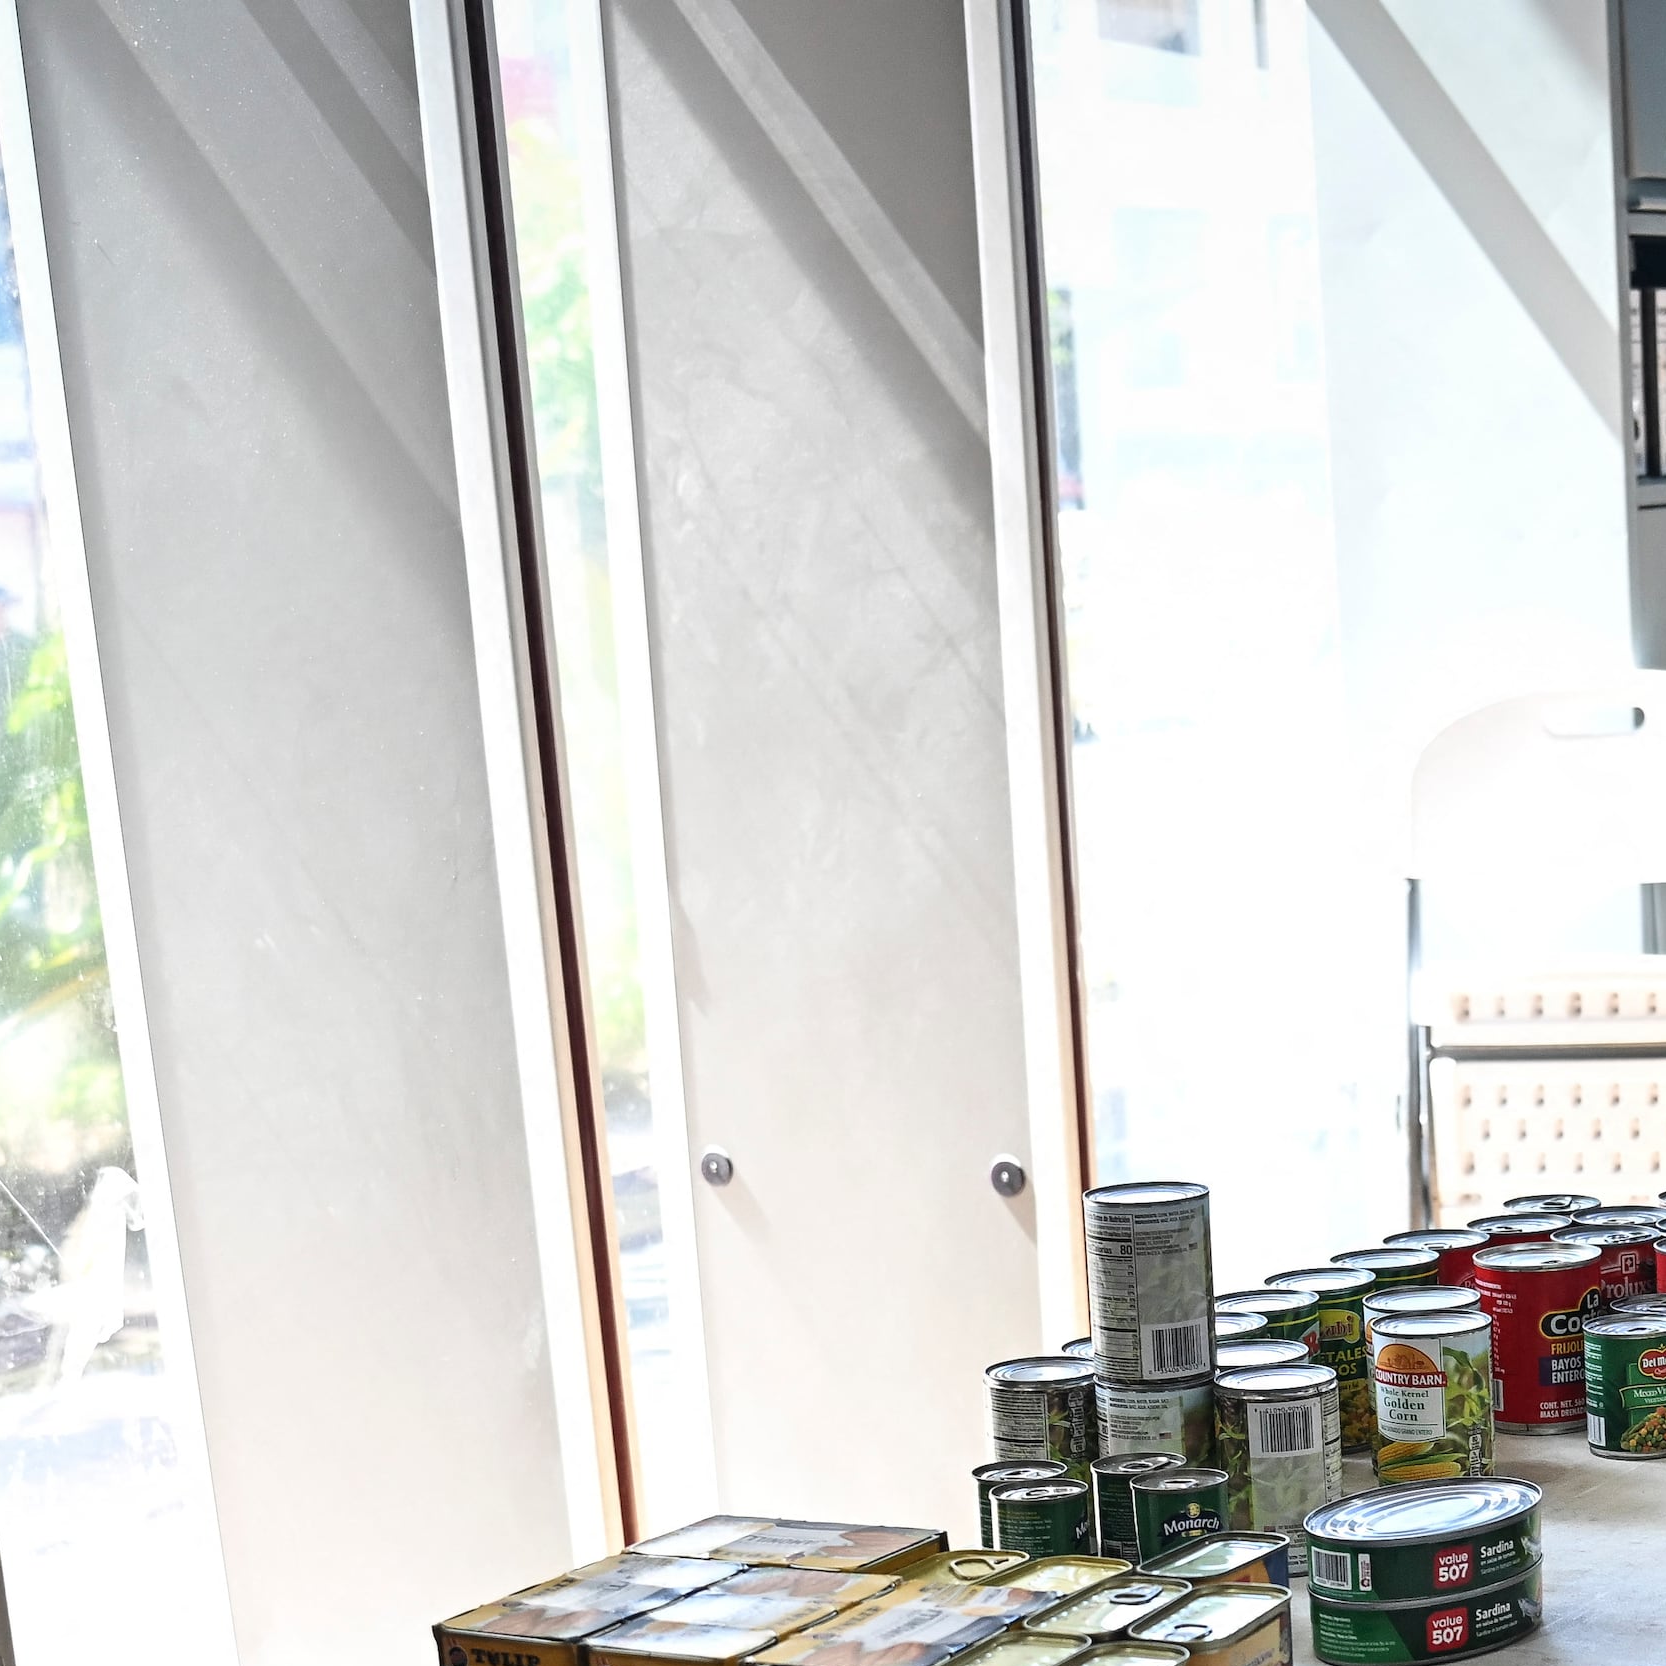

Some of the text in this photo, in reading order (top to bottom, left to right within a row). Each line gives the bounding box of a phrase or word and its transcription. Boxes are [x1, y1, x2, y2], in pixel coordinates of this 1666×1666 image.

[1120, 1245, 1132, 1255] 80
[1587, 1293, 1599, 1309] La
[1551, 1340, 1584, 1355] FRIJOLE
[1551, 1356, 1582, 1371] BAYOS
[1642, 1358, 1657, 1369] Del
[1375, 1369, 1443, 1386] COUNTRY BARN
[1402, 1390, 1429, 1398] Kernel
[1384, 1396, 1425, 1410] Golden
[1540, 1401, 1559, 1410] CONT.
[1389, 1409, 1418, 1421] Corn
[1540, 1409, 1559, 1418] MASA
[1163, 1516, 1220, 1537] Monarch
[1480, 1538, 1514, 1559] Sardina
[1438, 1552, 1469, 1567] value
[1438, 1563, 1470, 1583] 507
[1475, 1601, 1511, 1621] Sardina
[1432, 1615, 1463, 1629] value
[1432, 1626, 1463, 1645] 507
